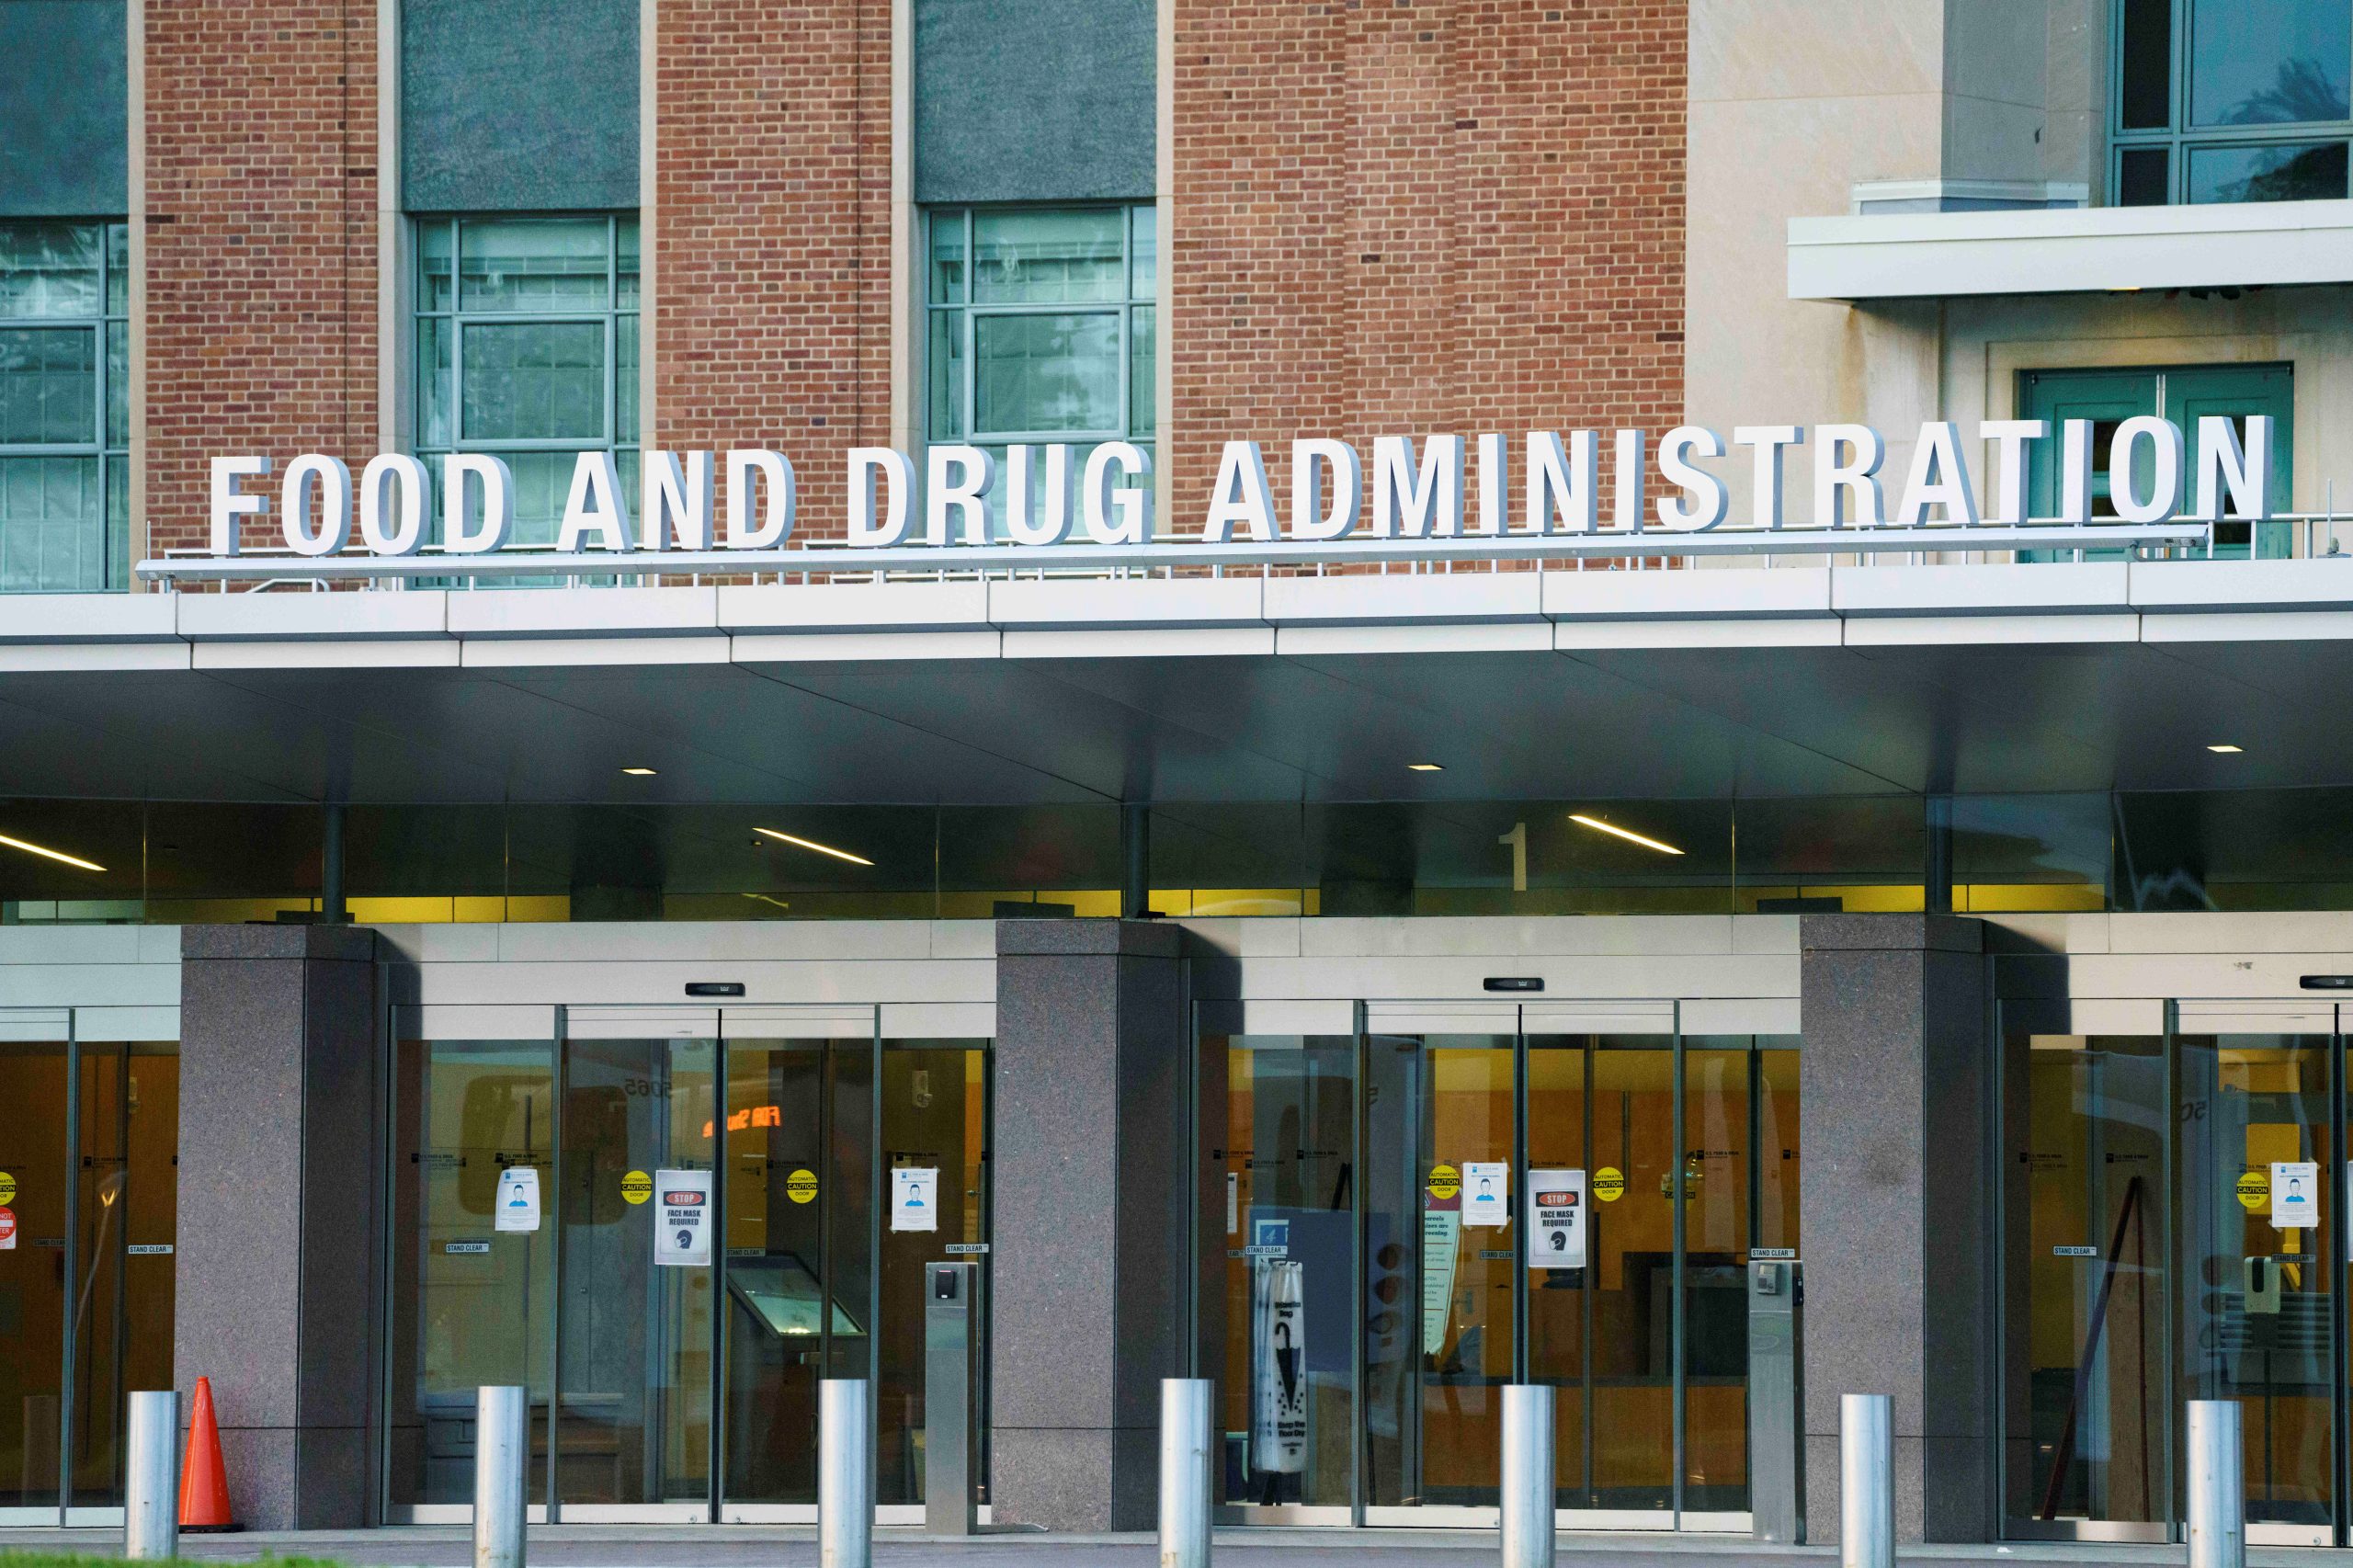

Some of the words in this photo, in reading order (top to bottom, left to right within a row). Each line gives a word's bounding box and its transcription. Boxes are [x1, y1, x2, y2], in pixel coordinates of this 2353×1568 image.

[210, 453, 513, 556] FOOD
[555, 449, 796, 552] AND
[847, 440, 1153, 549] DRUG
[1202, 415, 2274, 544] ADMINISTRATION
[1498, 822, 1527, 891] 1
[1547, 1195, 1567, 1203] STOP
[669, 1218, 699, 1226] REQUIRED
